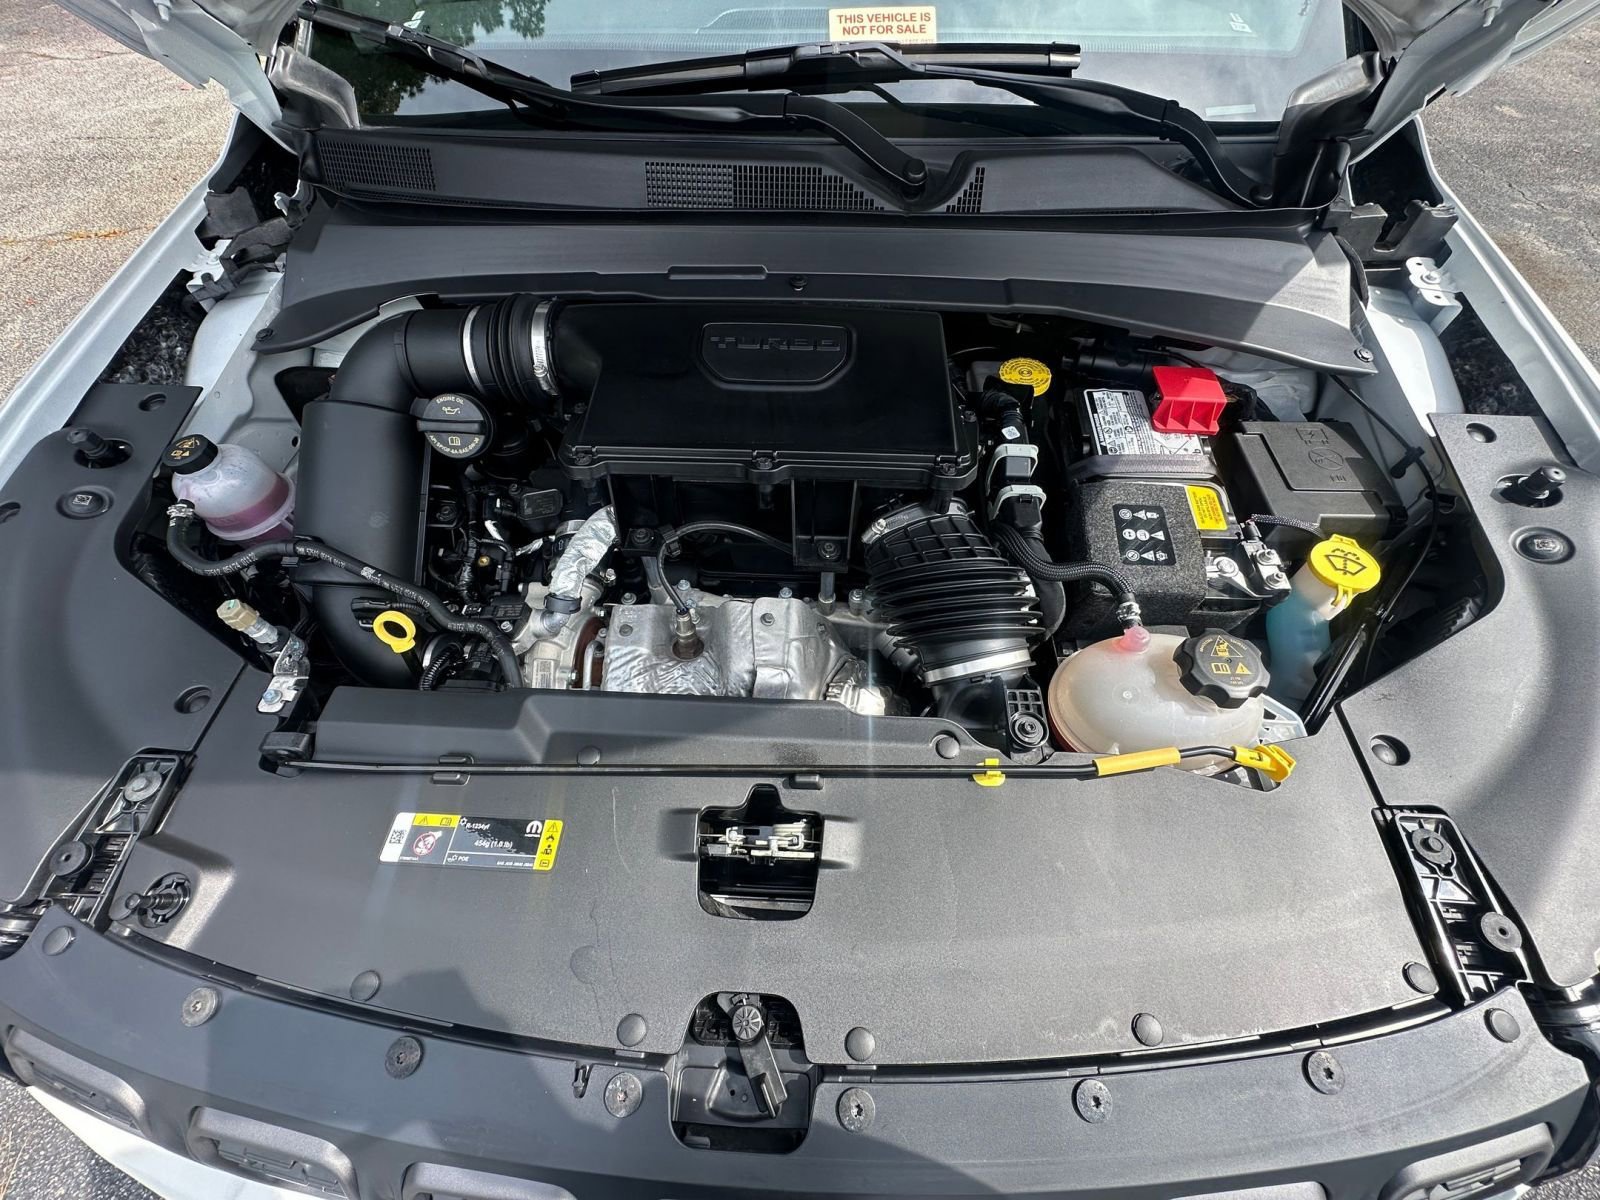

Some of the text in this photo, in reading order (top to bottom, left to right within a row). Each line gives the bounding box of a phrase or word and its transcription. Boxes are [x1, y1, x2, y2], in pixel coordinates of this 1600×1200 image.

[837, 12, 931, 24] THIS VEHICLE IS
[842, 24, 926, 35] NOT FOR SALE
[710, 336, 841, 351] TURBO
[436, 396, 464, 405] ENGINE OIL
[429, 435, 438, 444] API
[474, 840, 490, 848] 454g
